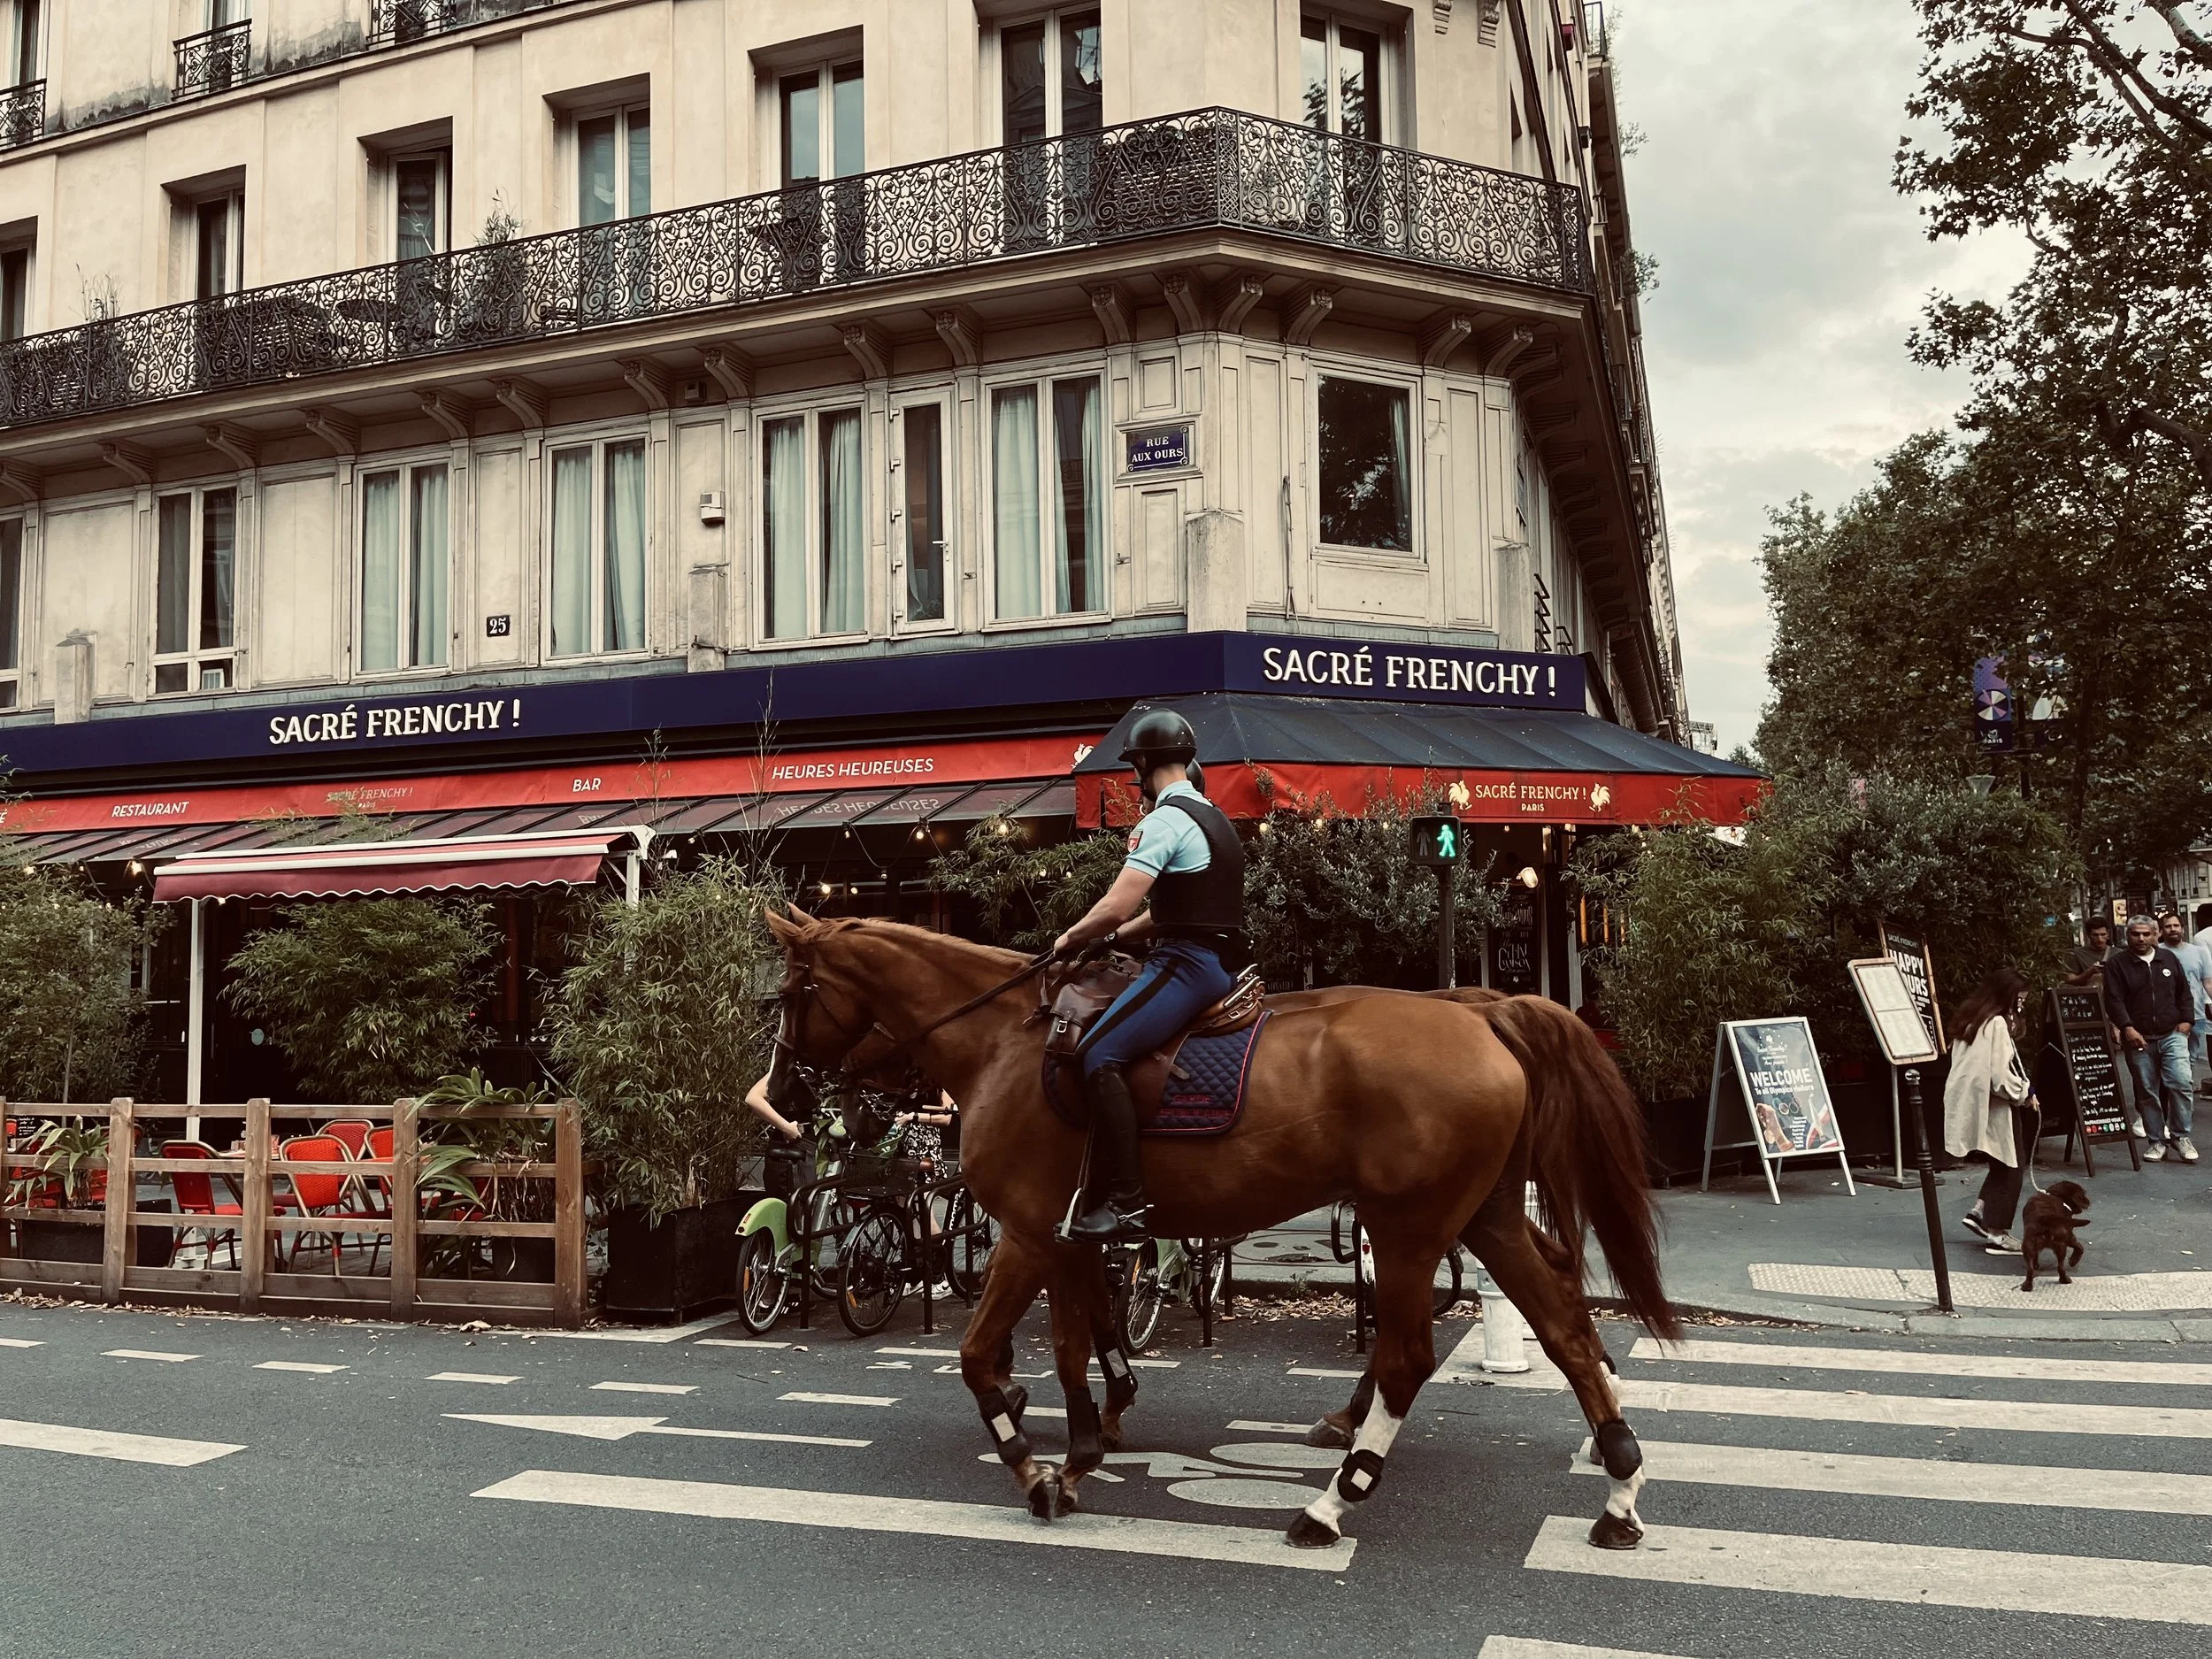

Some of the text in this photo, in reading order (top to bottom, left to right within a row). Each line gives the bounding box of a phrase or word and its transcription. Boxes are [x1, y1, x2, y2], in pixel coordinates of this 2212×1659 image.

[1146, 436, 1169, 448] RUE
[1132, 448, 1183, 463] AUX OURS
[489, 617, 506, 634] 25
[1263, 645, 1373, 686] SACRÉ
[1386, 655, 1539, 696] FRENCHY
[269, 703, 357, 745] SACRÉ
[365, 700, 505, 738] FRENCHY
[772, 757, 934, 780] HEURES HEUREUSES
[360, 787, 408, 800] FRENCHY
[572, 777, 602, 793] BAR
[1475, 781, 1517, 799] SACRÉ
[1520, 785, 1579, 800] FRENCHY
[111, 801, 189, 818] RESTAURANT
[1521, 803, 1545, 812] PARIS
[1888, 949, 1924, 977] HAPPY
[1749, 1067, 1813, 1087] WELCOME
